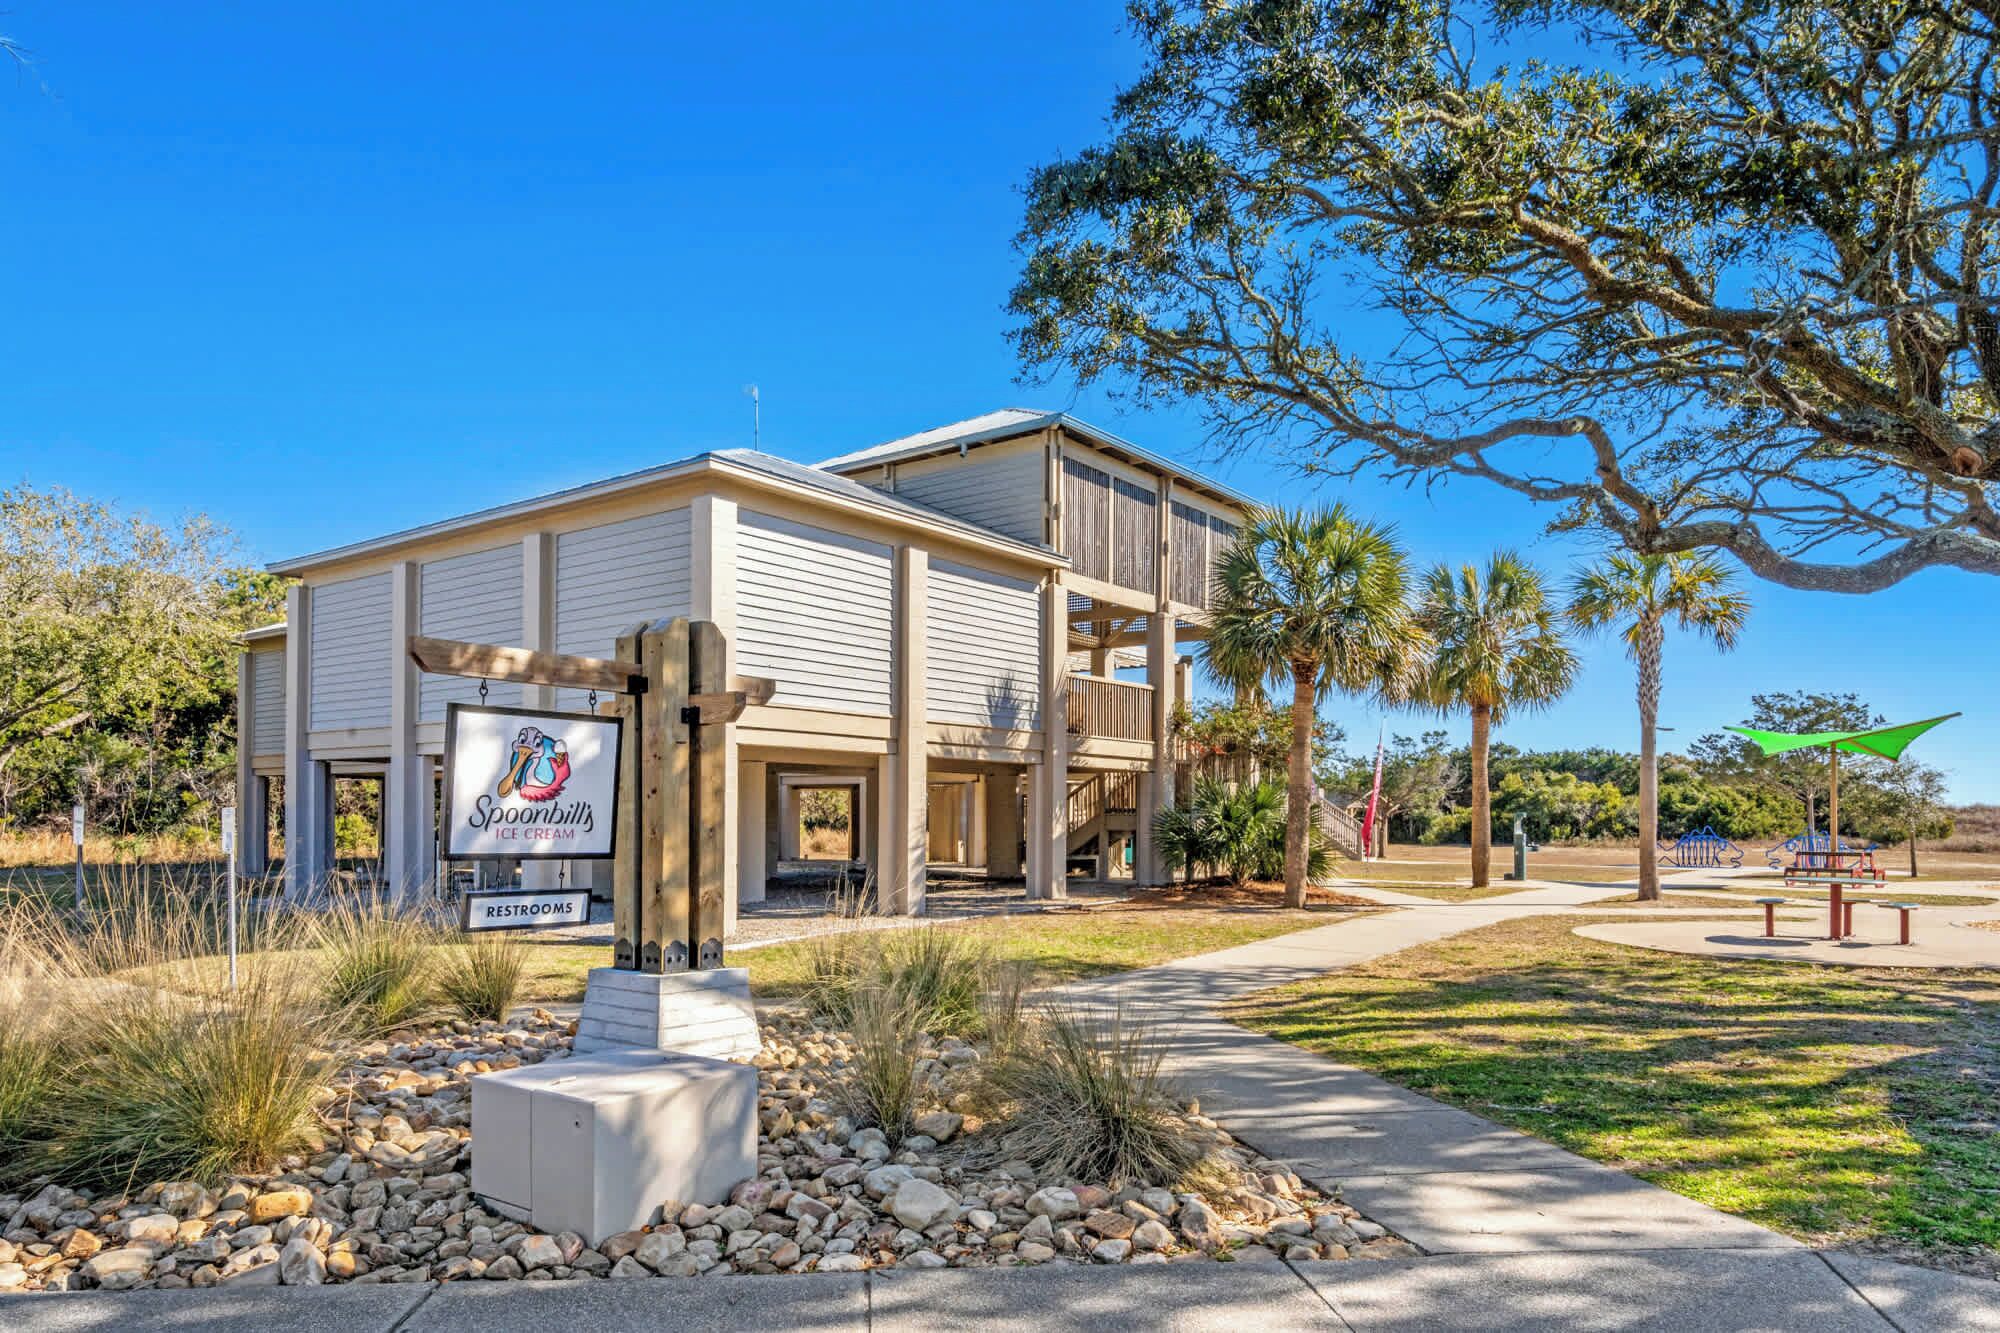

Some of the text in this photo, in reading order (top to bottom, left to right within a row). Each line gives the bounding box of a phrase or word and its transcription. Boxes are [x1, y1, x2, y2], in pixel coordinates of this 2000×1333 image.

[495, 827, 575, 840] ICE CREAM
[487, 902, 573, 917] RESTROOMS
